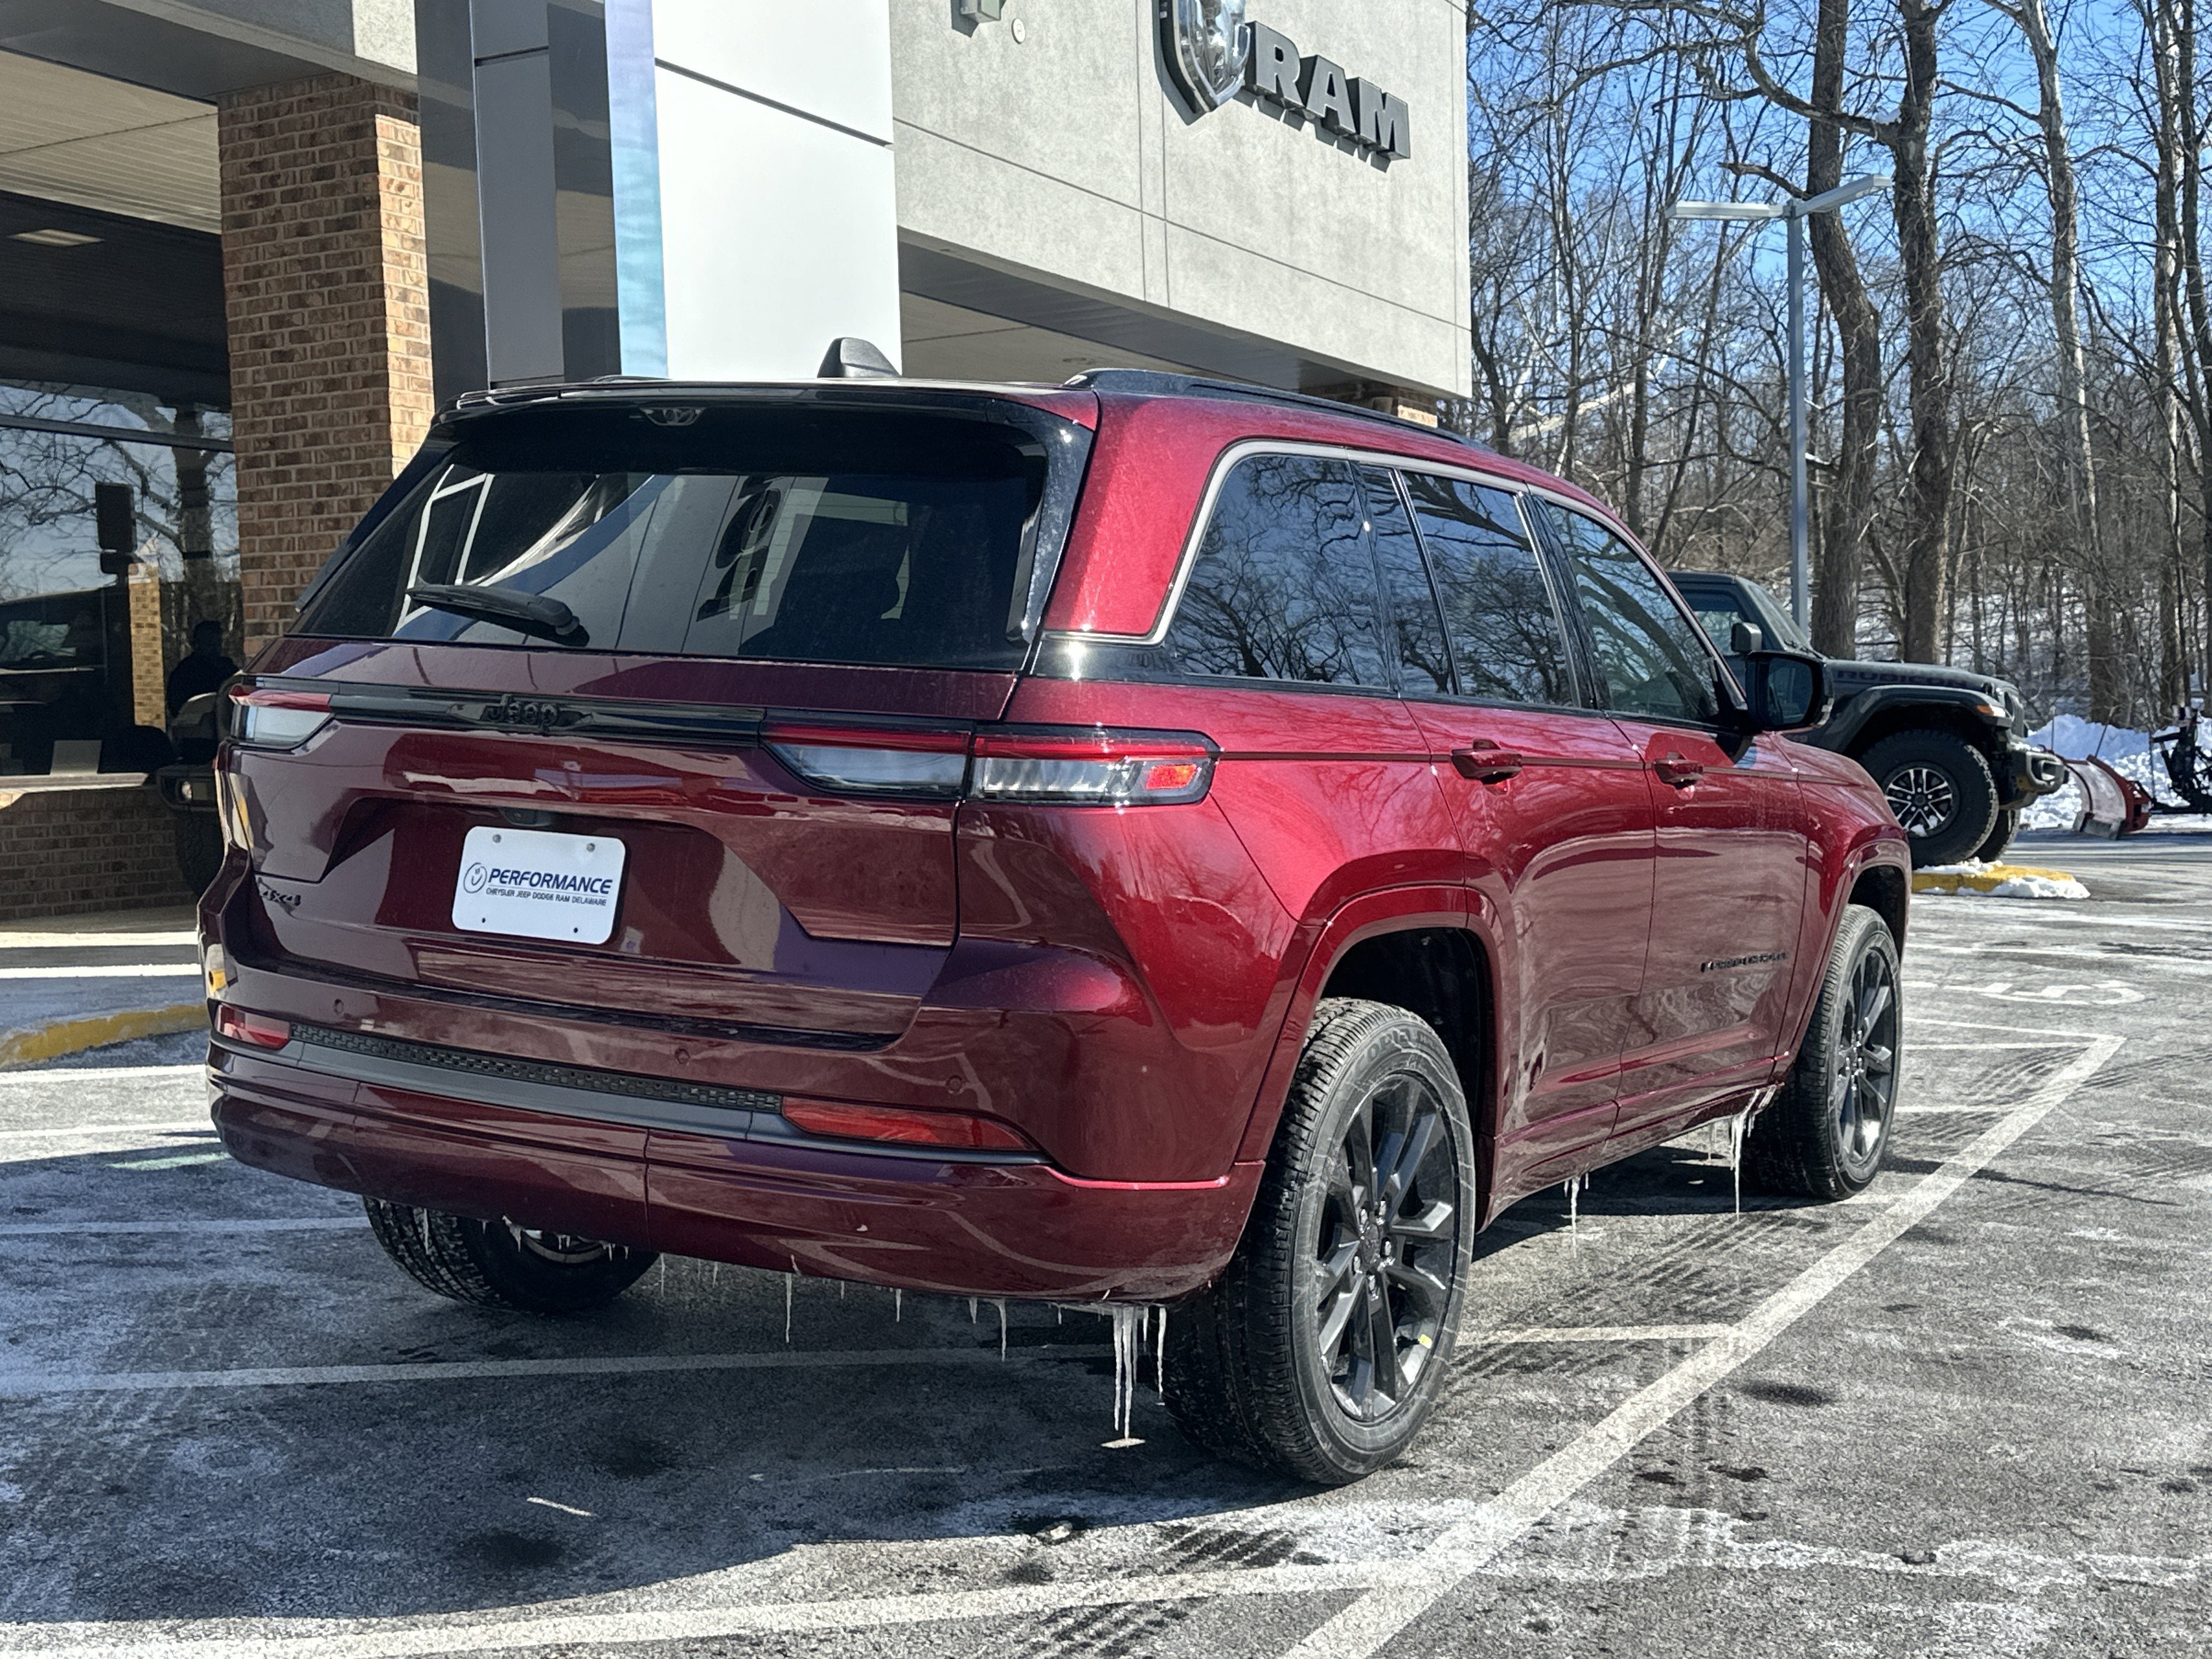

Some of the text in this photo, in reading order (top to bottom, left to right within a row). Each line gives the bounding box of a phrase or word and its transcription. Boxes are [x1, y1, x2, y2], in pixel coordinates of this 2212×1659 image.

[1253, 20, 1410, 160] RAM
[1837, 670, 1968, 687] RUBICON
[486, 693, 558, 733] Jeep
[488, 868, 613, 894] PERFORMANCE
[486, 887, 607, 906] CHRYSLER JEEP DODGE RAM DELAWARE
